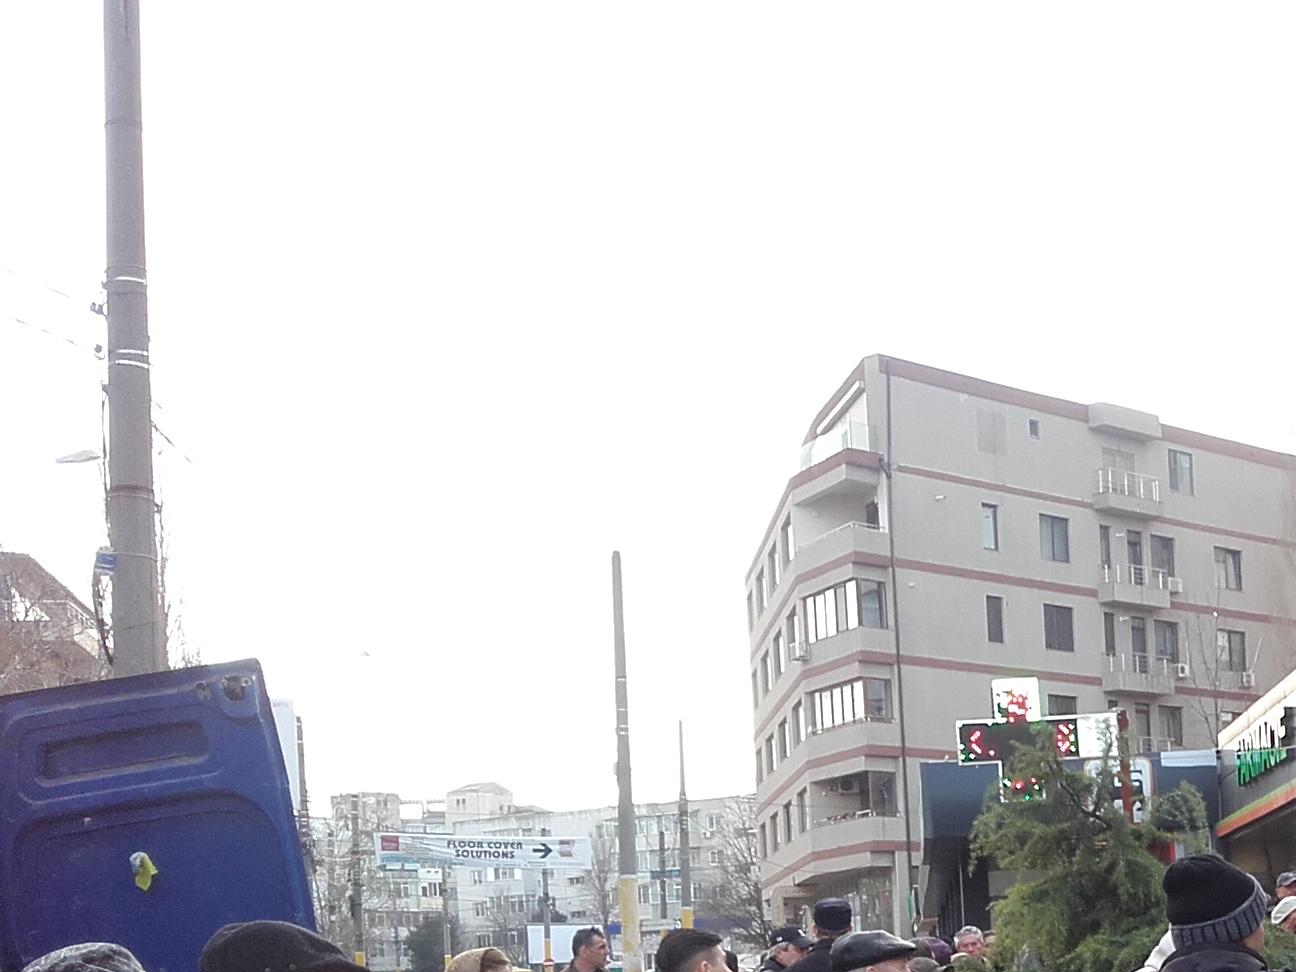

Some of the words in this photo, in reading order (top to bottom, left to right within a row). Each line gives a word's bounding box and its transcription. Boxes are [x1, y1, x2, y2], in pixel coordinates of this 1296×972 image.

[447, 839, 484, 850] FLOOR
[487, 840, 523, 850] COVER
[454, 849, 516, 860] SOLUTIONS
